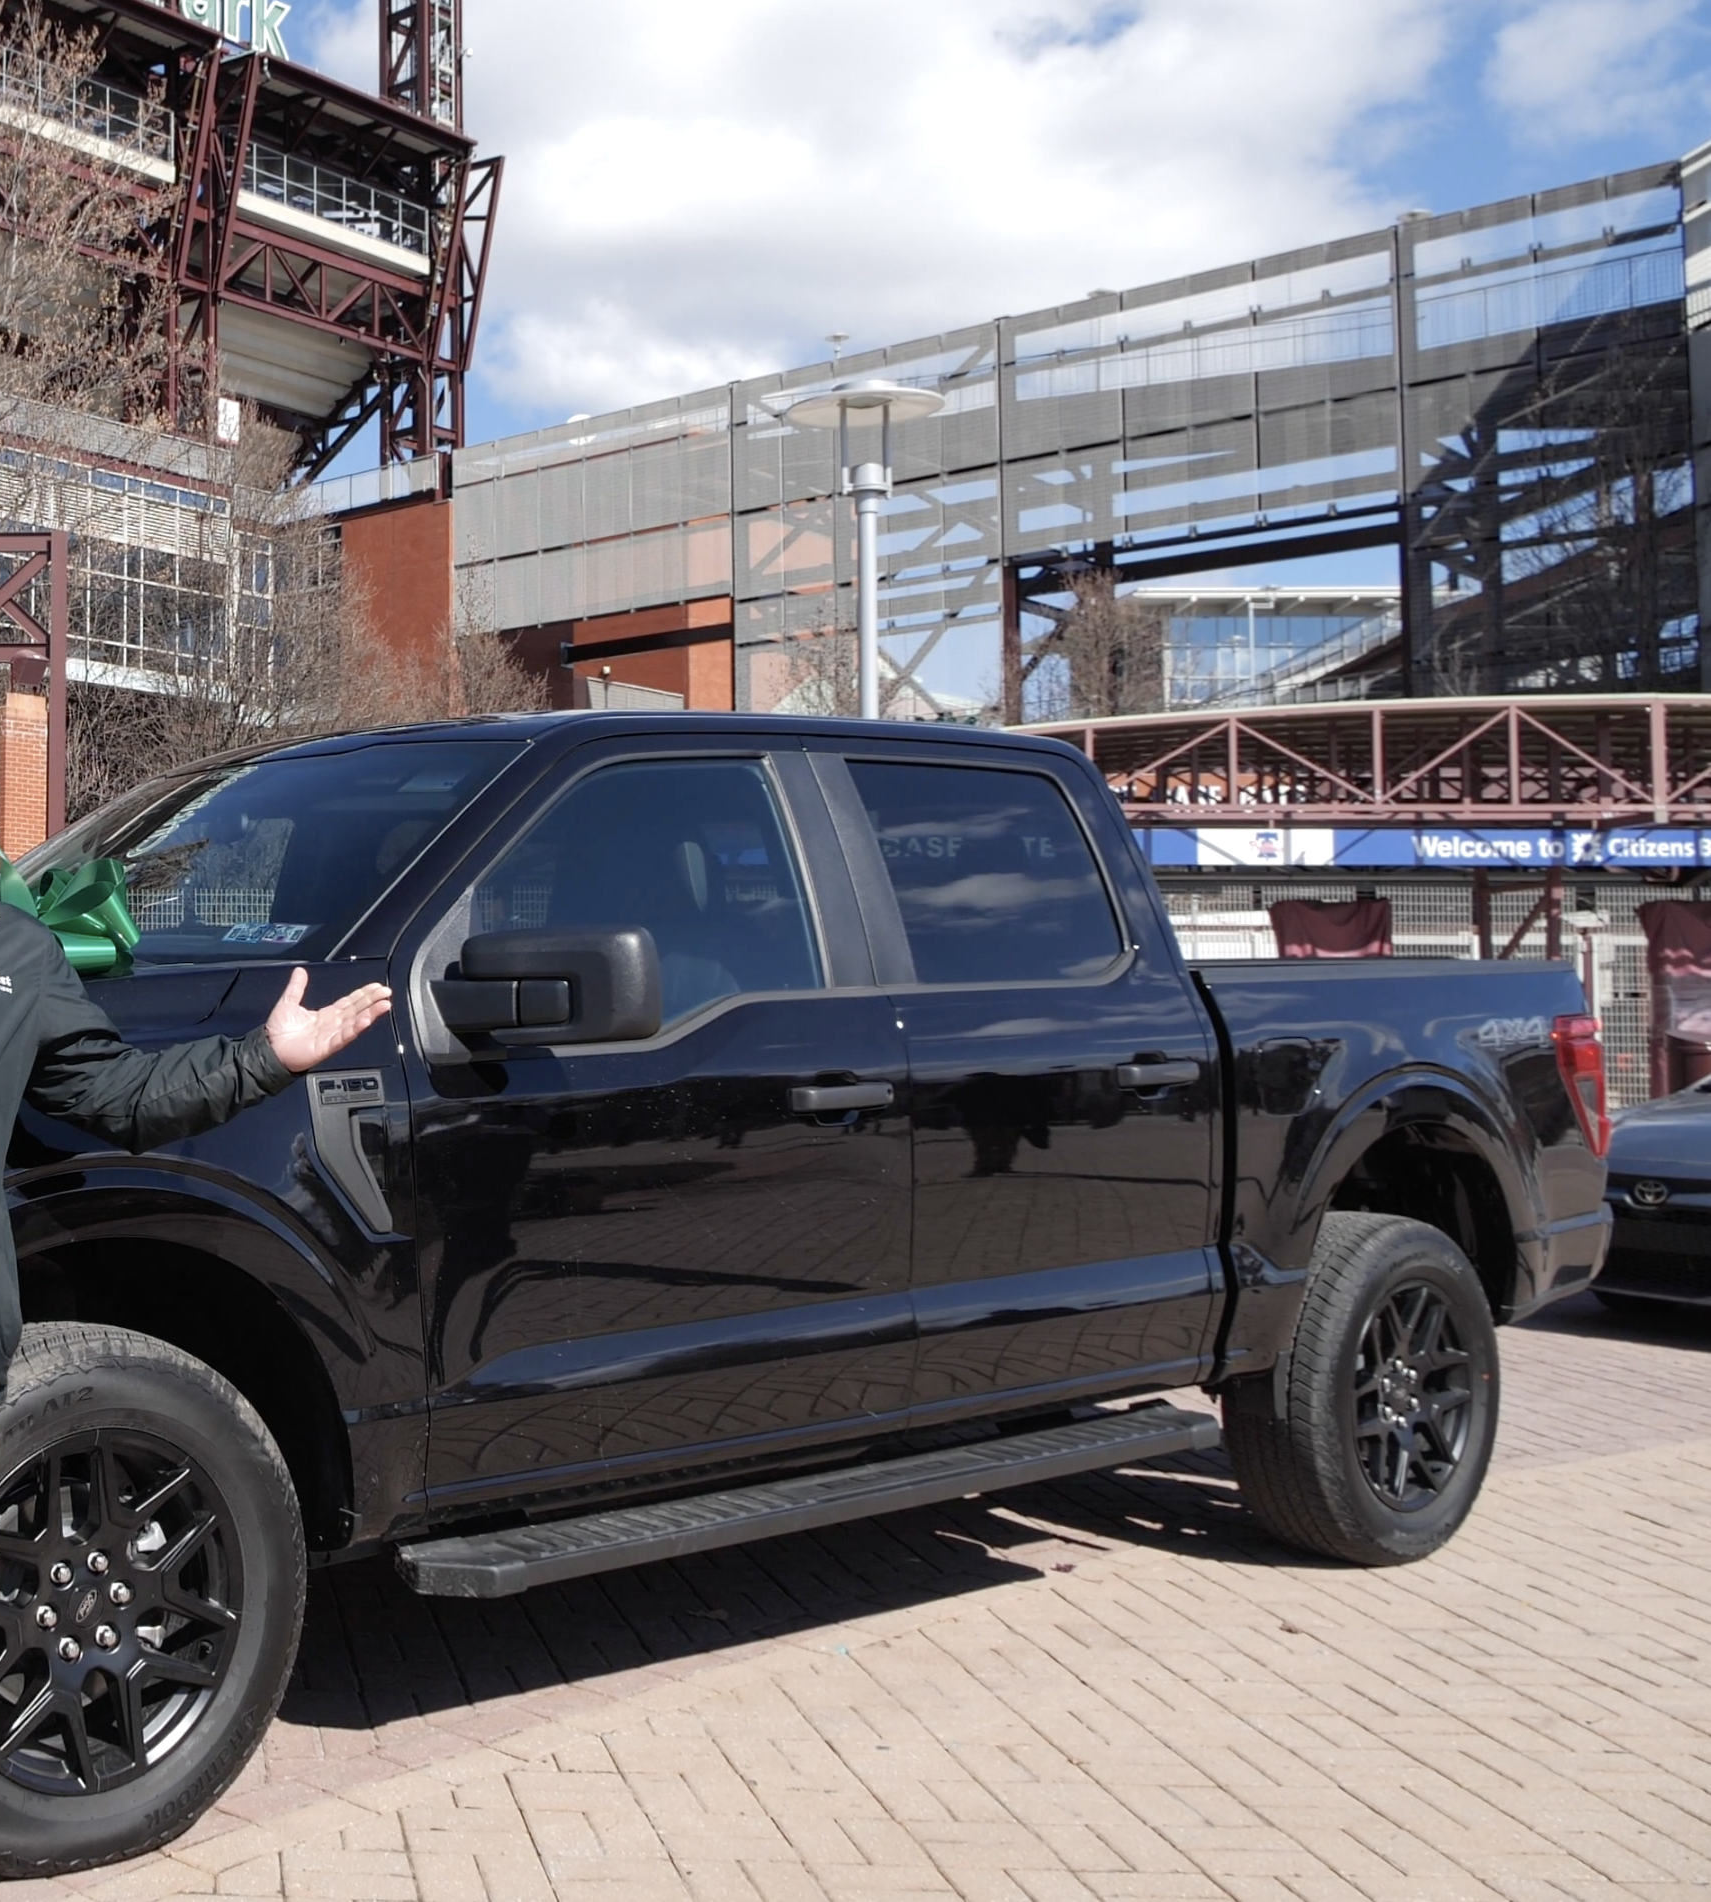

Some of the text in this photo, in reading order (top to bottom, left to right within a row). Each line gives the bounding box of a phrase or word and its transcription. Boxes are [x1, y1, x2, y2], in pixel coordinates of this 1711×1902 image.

[178, 0, 292, 61] ark
[1412, 835, 1530, 858] Welcome
[1539, 838, 1564, 858] to
[1608, 837, 1696, 858] Citizens
[319, 1077, 379, 1094] F-150
[42, 1386, 94, 1417] AT2
